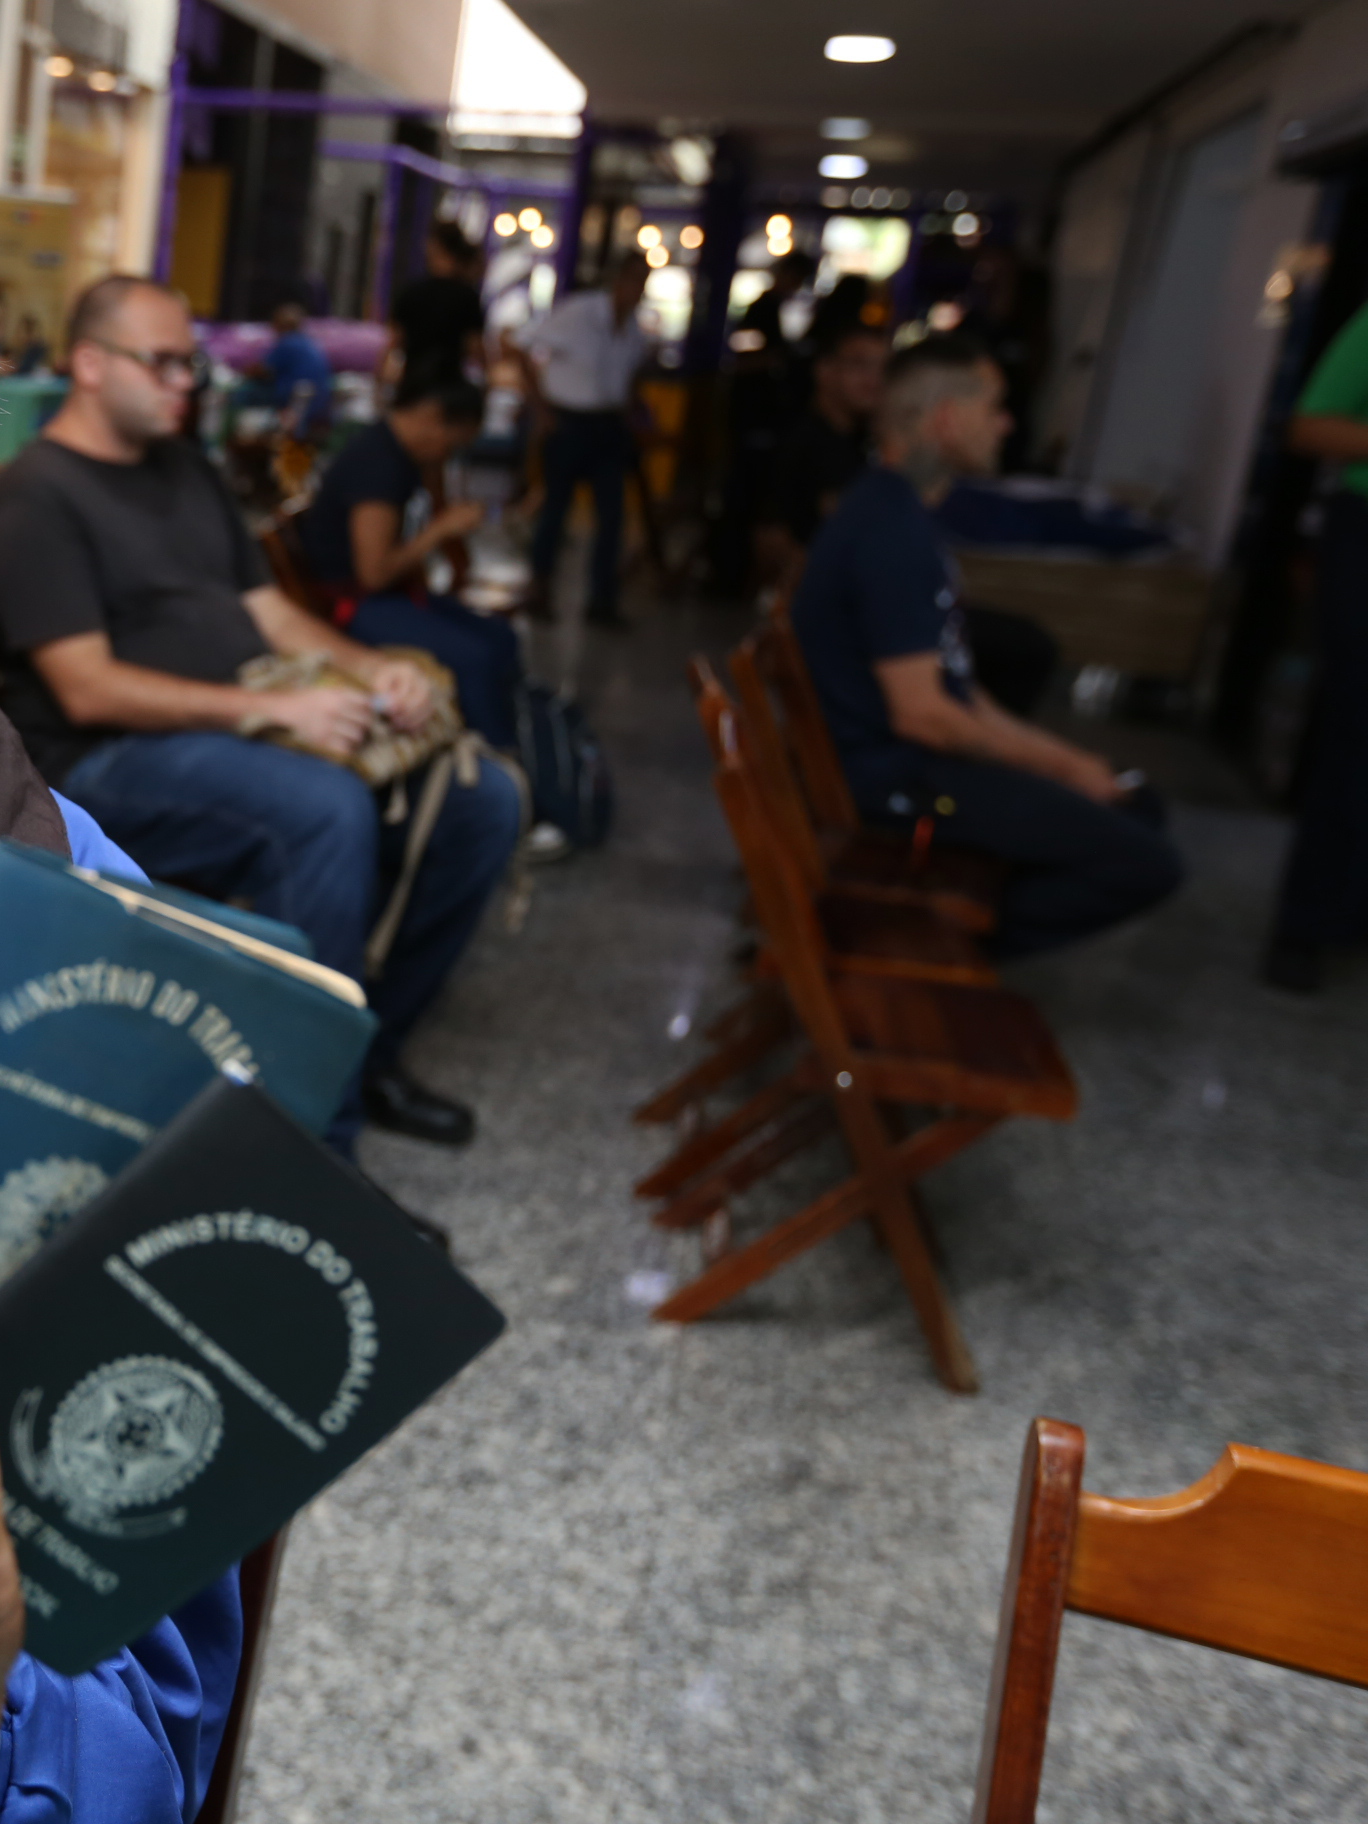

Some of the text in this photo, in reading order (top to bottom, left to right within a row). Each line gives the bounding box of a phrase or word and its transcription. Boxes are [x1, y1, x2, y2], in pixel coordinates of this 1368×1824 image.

[150, 979, 200, 1027] DO
[303, 1239, 353, 1285] DO
[319, 1277, 379, 1435] TRABALHO
